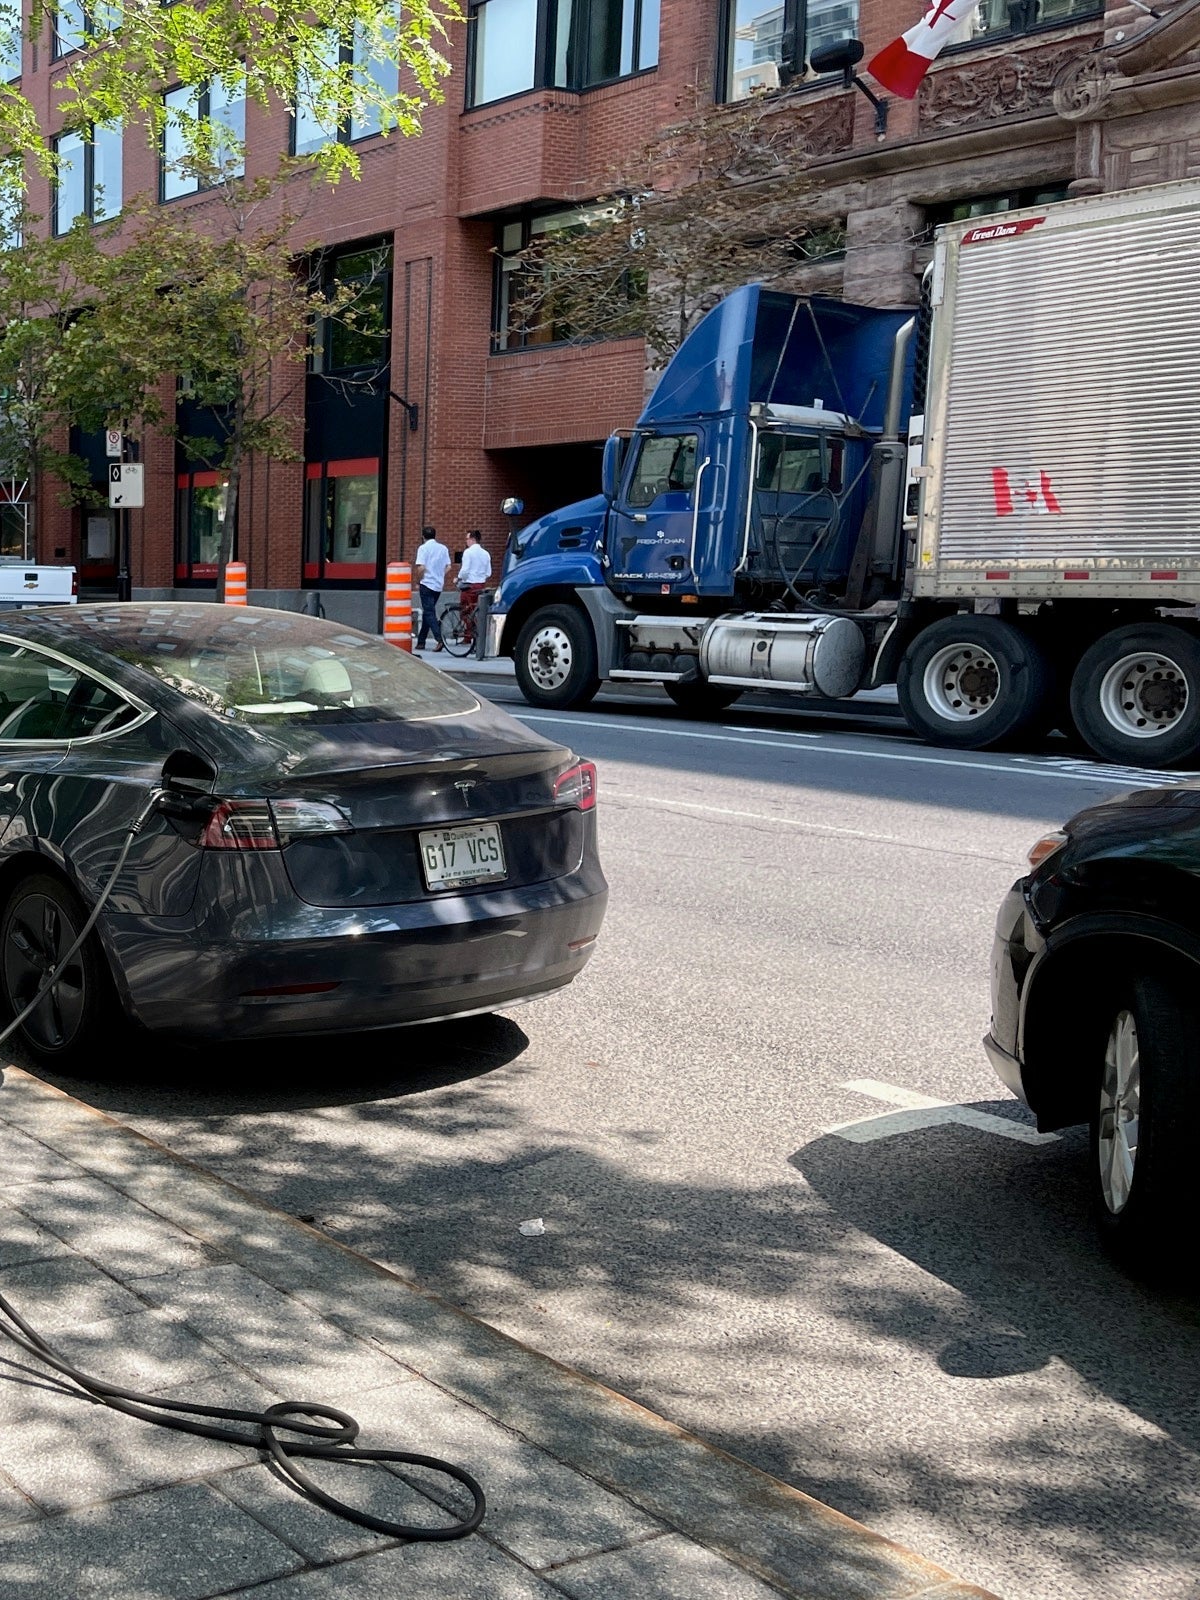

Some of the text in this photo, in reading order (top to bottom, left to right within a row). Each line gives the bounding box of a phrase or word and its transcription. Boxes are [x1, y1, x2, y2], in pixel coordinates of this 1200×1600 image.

[971, 226, 1017, 241] Great Dane
[426, 837, 499, 870] G17 VCS
